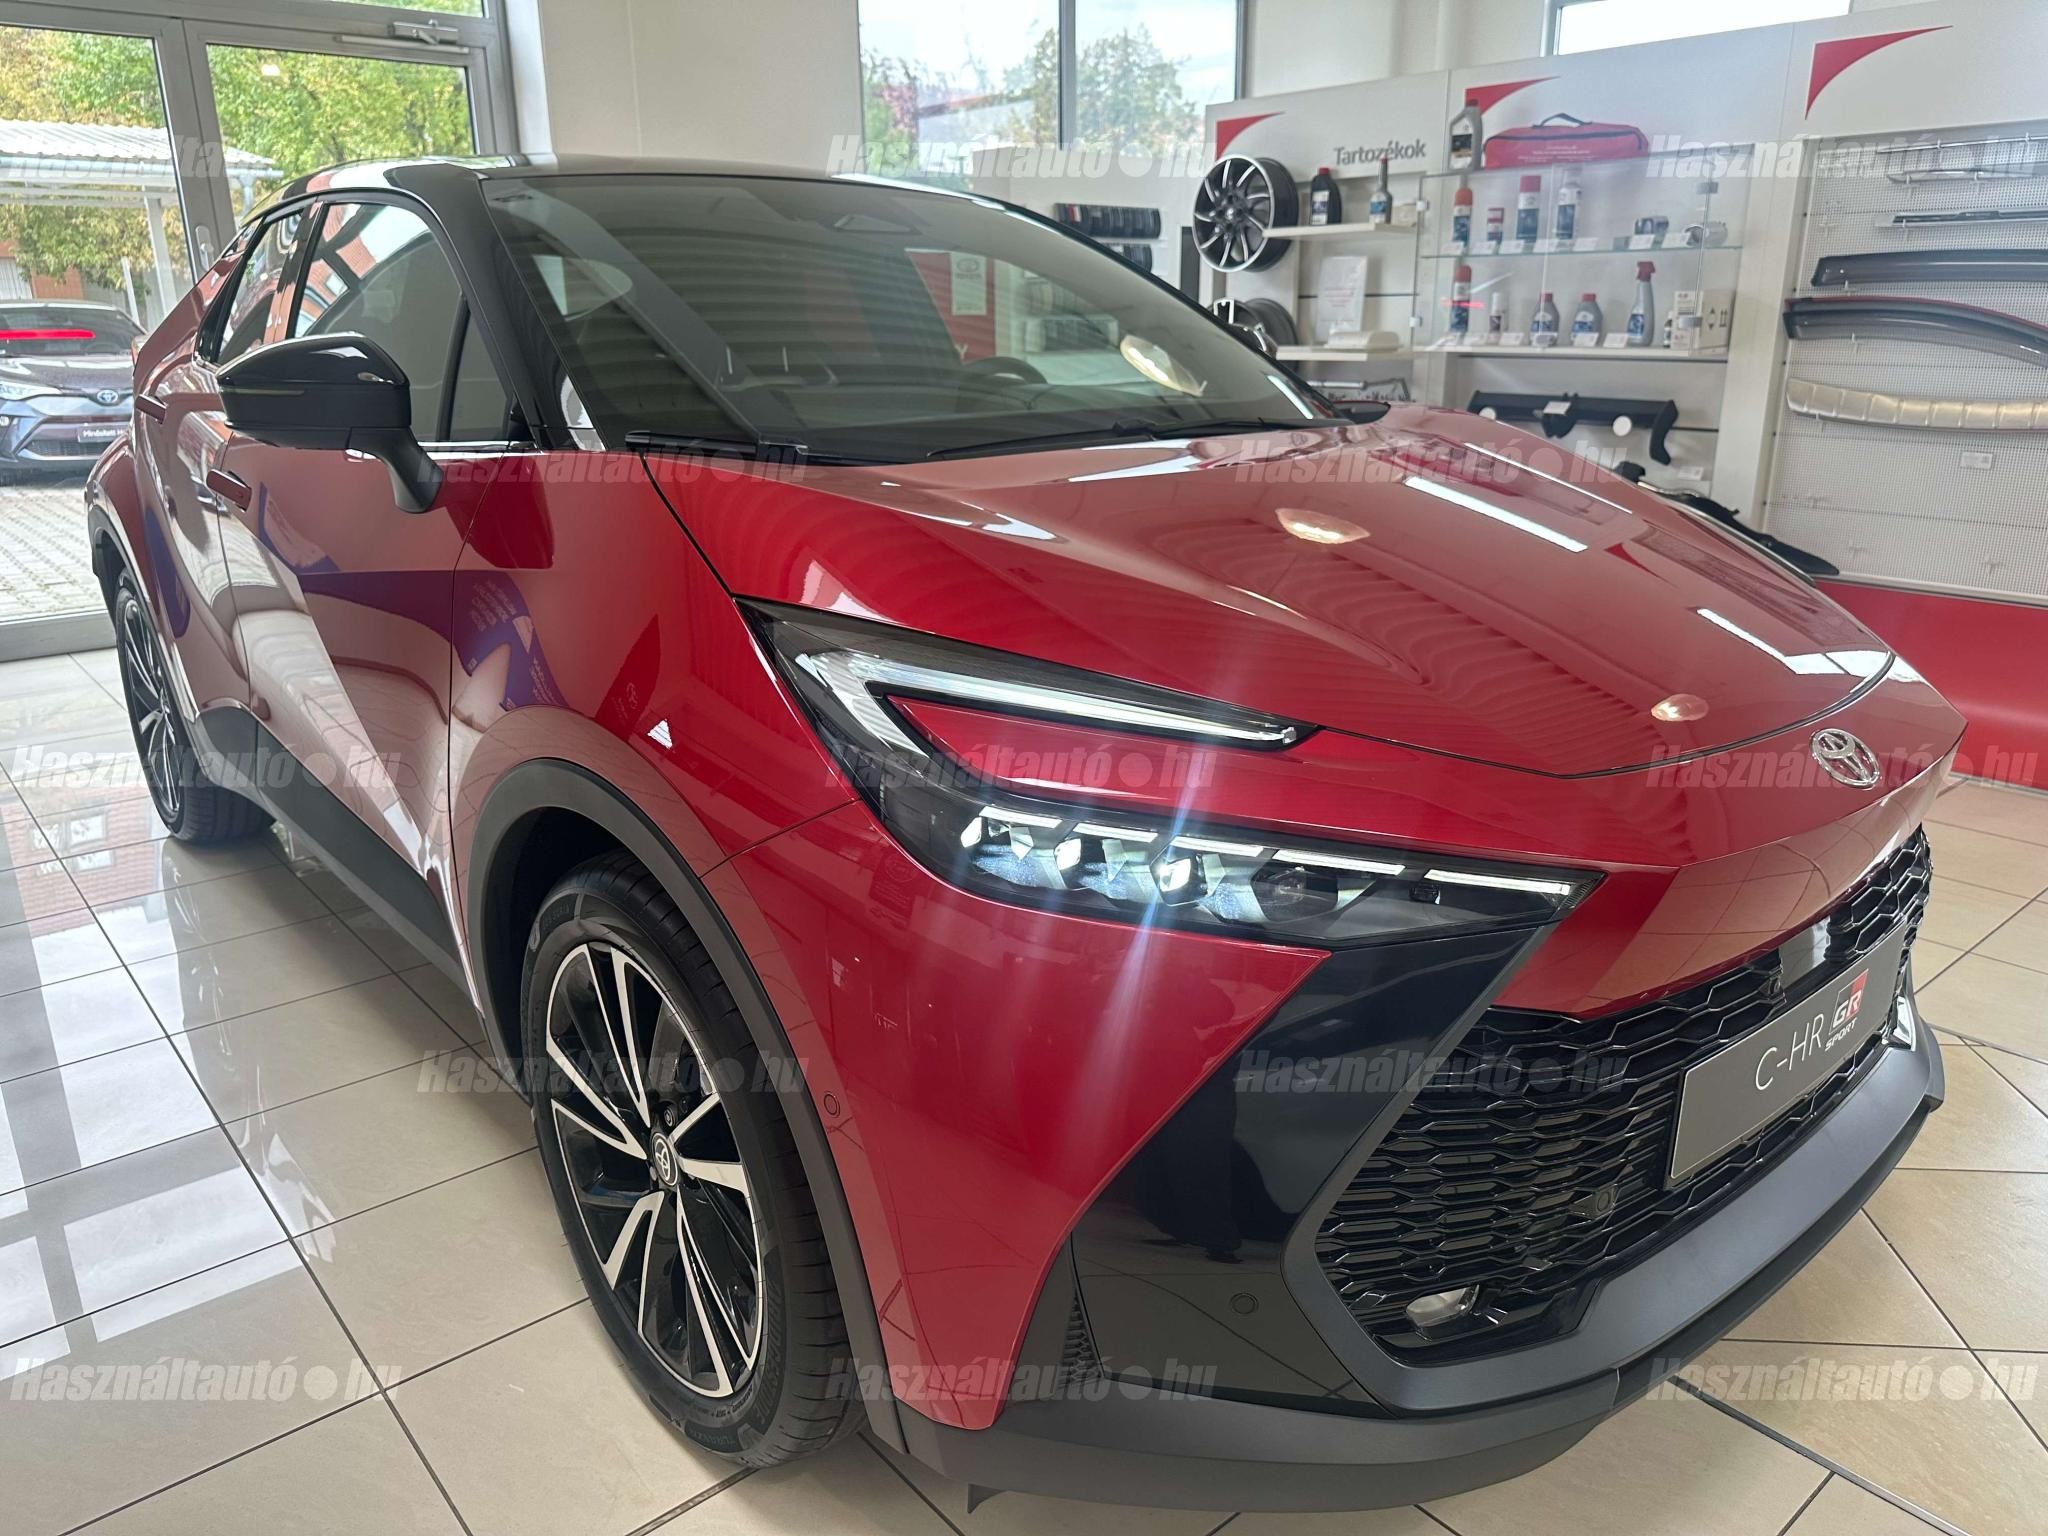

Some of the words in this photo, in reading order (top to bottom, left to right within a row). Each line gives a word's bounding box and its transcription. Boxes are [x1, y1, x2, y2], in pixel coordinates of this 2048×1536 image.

[1334, 139, 1427, 165] Tartozékok
[1832, 991, 1862, 1029] GR
[1755, 1014, 1824, 1091] C-HR
[1824, 1017, 1858, 1052] SPORT
